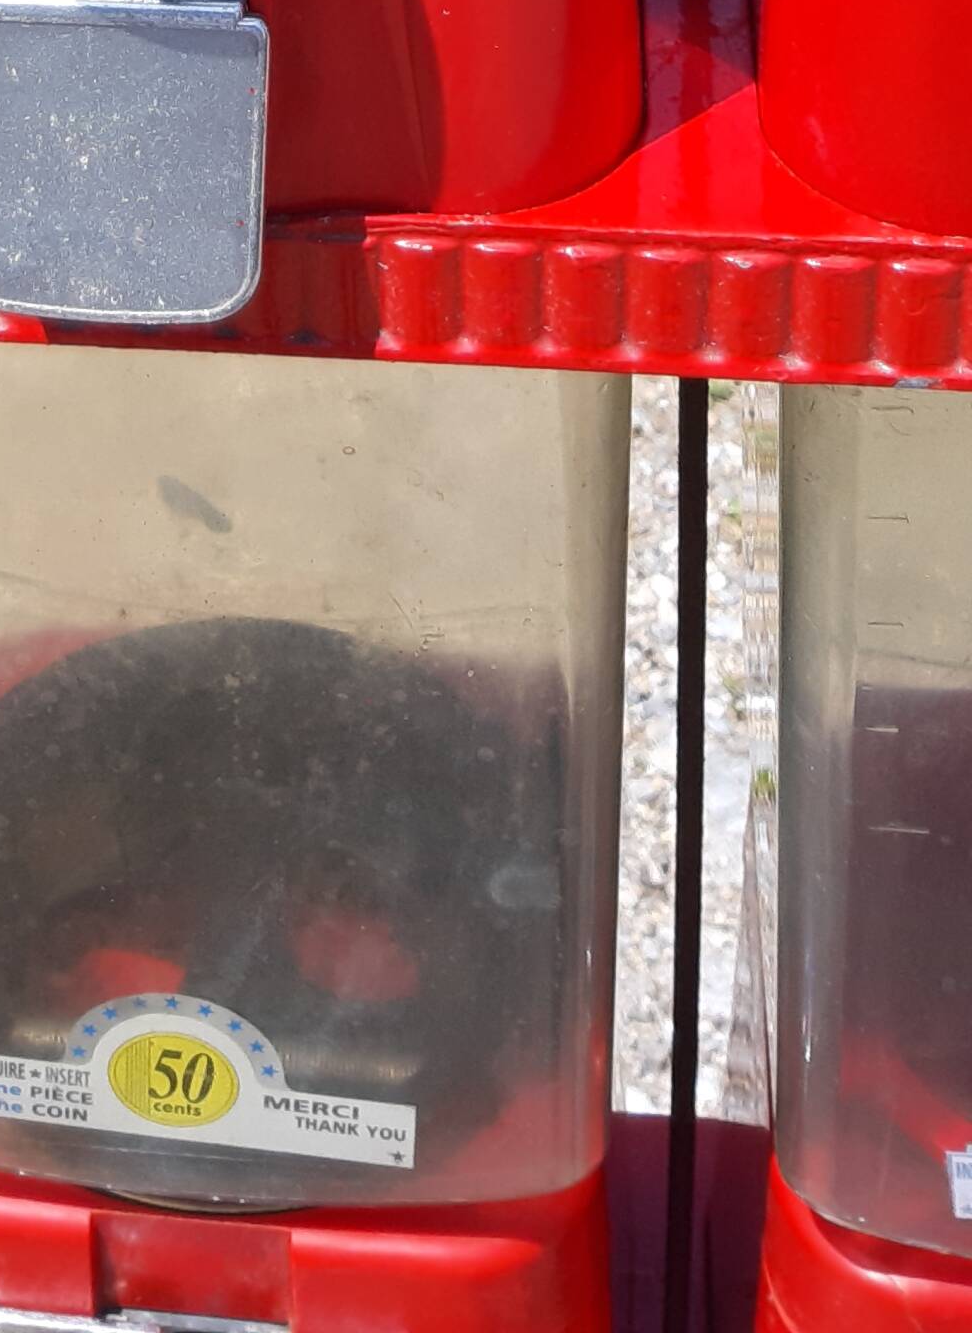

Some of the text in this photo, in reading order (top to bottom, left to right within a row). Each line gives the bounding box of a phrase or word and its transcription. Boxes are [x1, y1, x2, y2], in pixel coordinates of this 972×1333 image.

[45, 1066, 90, 1087] INSERT
[148, 1050, 215, 1104] 50
[30, 1083, 93, 1105] PIÈCE
[31, 1104, 88, 1121] COIN
[154, 1101, 202, 1117] cents
[263, 1094, 360, 1119] MERCI
[295, 1115, 407, 1142] THANK YOU
